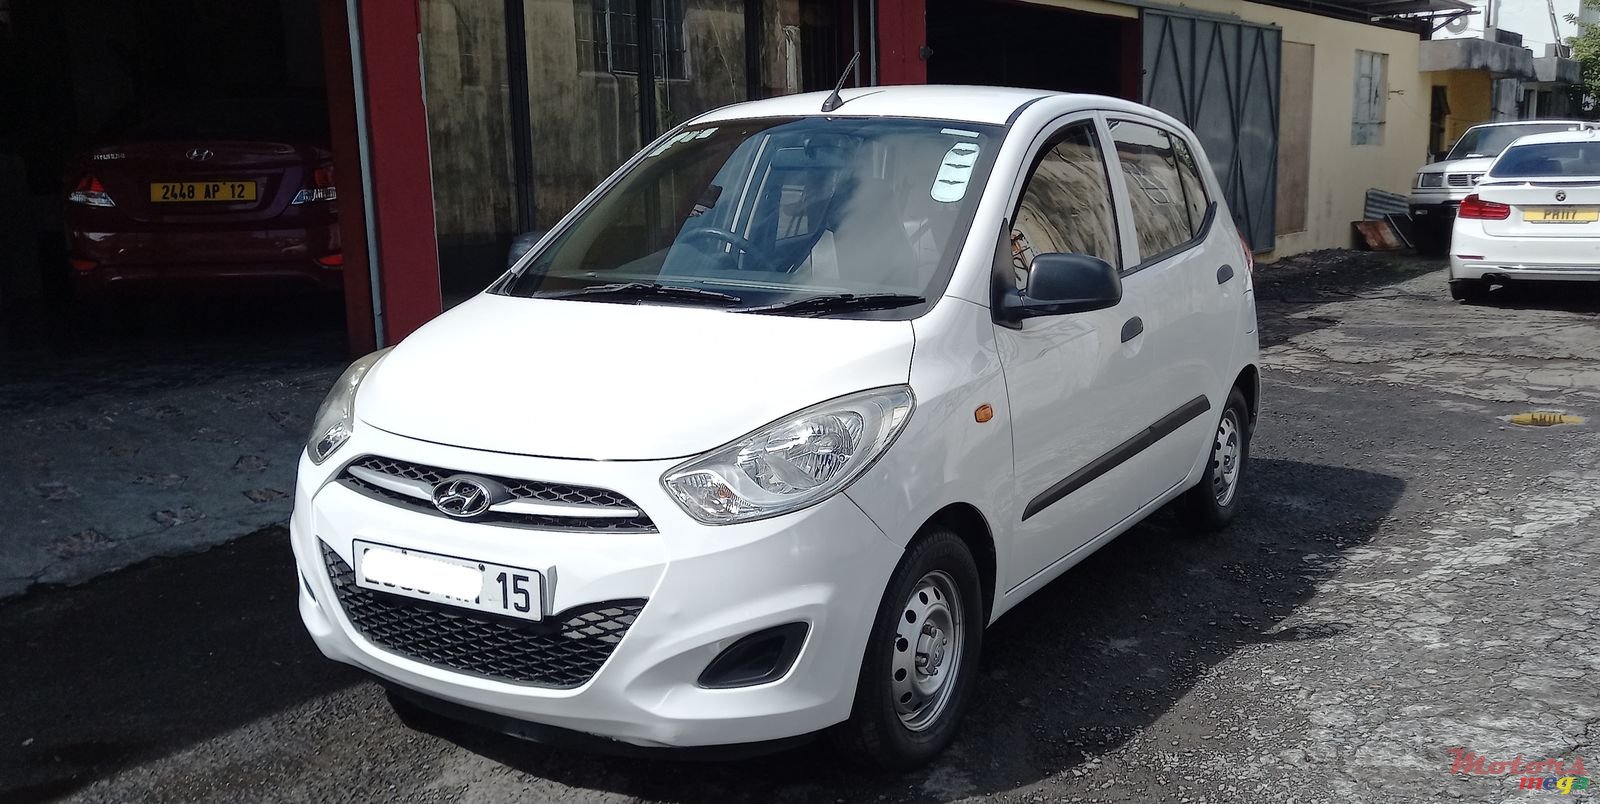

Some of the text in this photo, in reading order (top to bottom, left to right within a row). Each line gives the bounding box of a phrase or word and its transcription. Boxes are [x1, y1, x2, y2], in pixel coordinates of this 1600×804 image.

[161, 183, 245, 200] 2448 AP 12
[496, 571, 531, 613] 15
